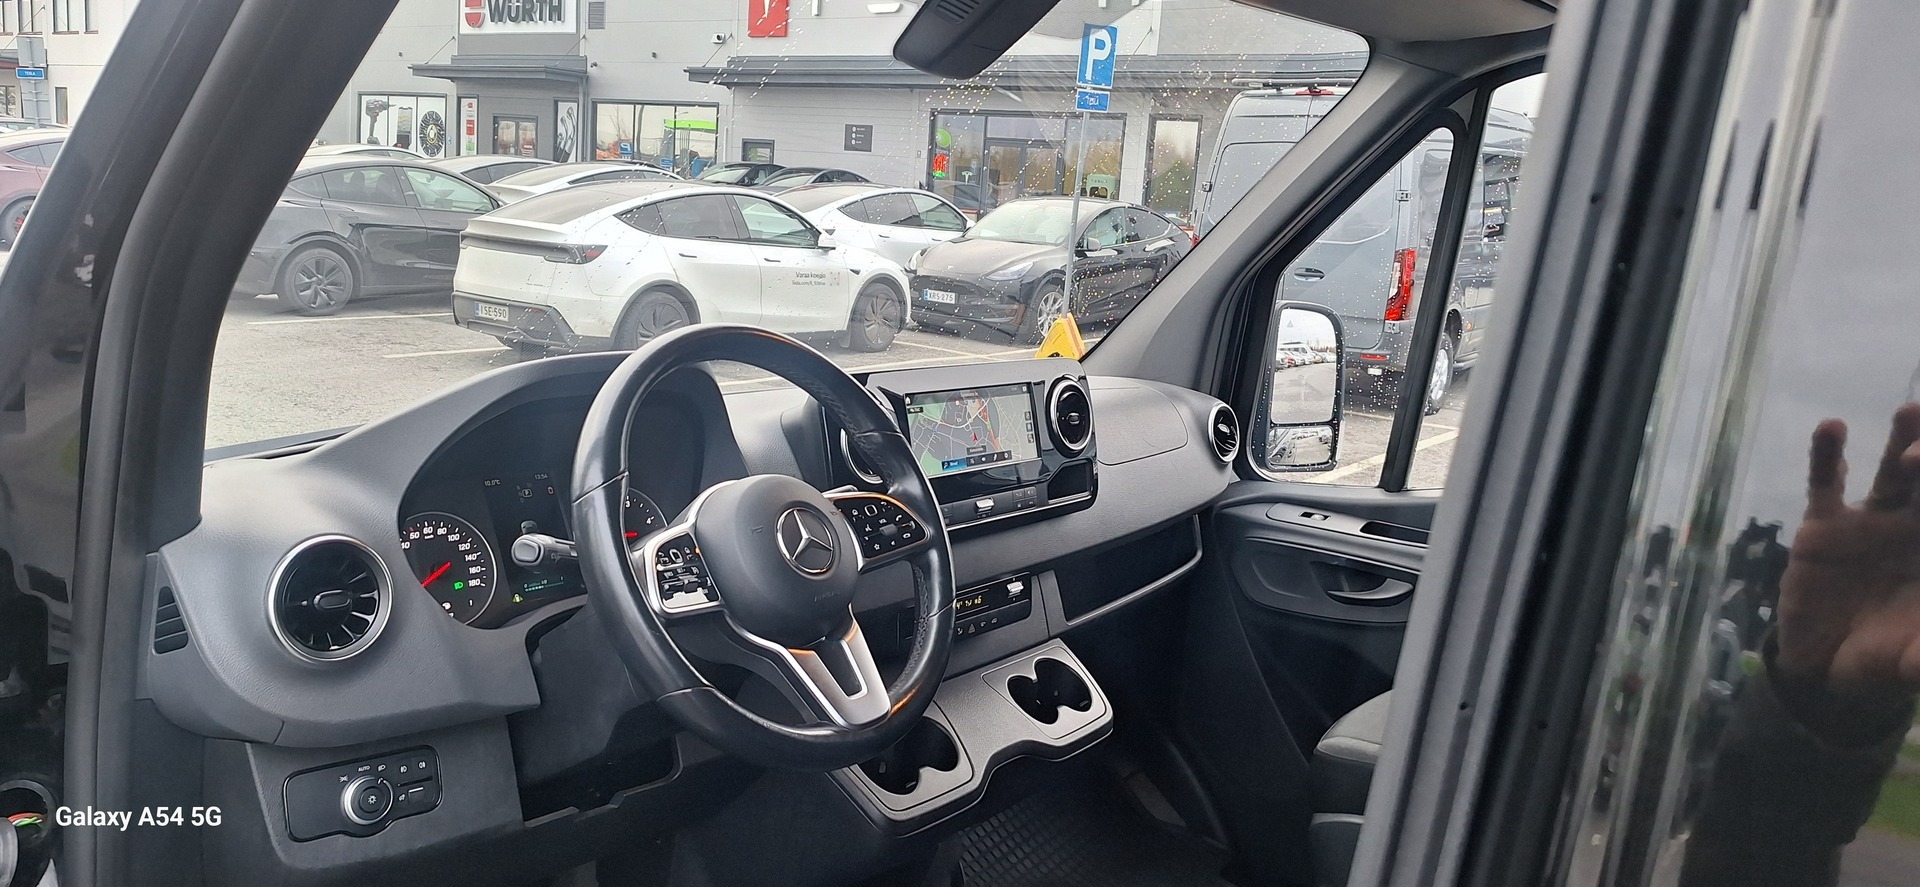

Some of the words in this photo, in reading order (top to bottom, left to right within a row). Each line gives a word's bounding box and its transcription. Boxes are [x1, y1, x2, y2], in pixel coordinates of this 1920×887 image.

[1086, 28, 1111, 80] P
[625, 500, 631, 508] 3
[423, 526, 433, 534] 60
[437, 527, 447, 536] 80
[409, 531, 420, 540] 50
[447, 533, 460, 542] 100
[458, 542, 471, 551] 120
[465, 553, 478, 562] 140
[468, 565, 481, 574] 160
[468, 578, 481, 587] 180
